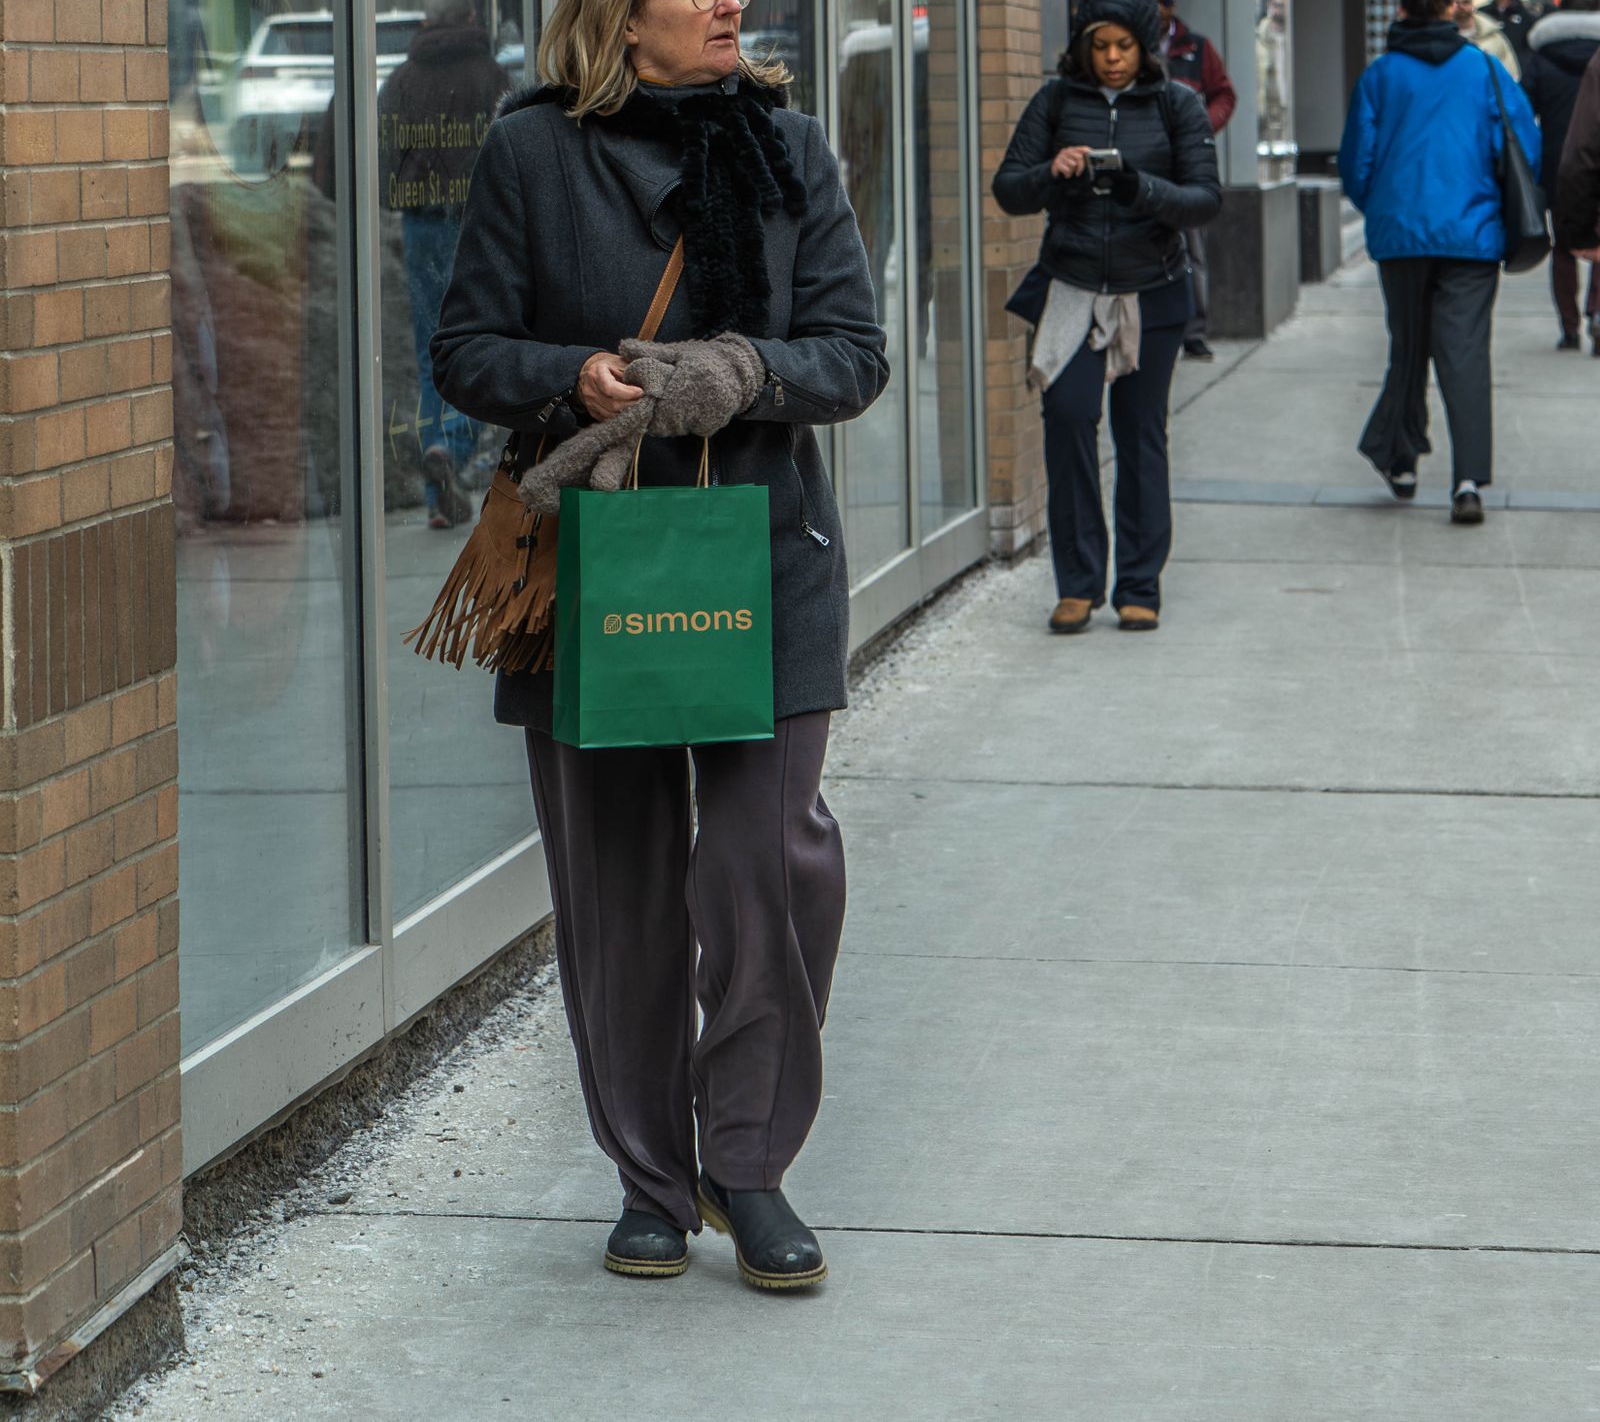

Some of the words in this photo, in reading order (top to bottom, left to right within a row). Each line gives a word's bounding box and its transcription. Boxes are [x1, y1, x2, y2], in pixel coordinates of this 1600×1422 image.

[391, 113, 436, 149] Toronto
[439, 113, 471, 148] Eaton
[389, 171, 425, 210] Queen
[429, 169, 446, 207] St.
[625, 609, 753, 635] simons
